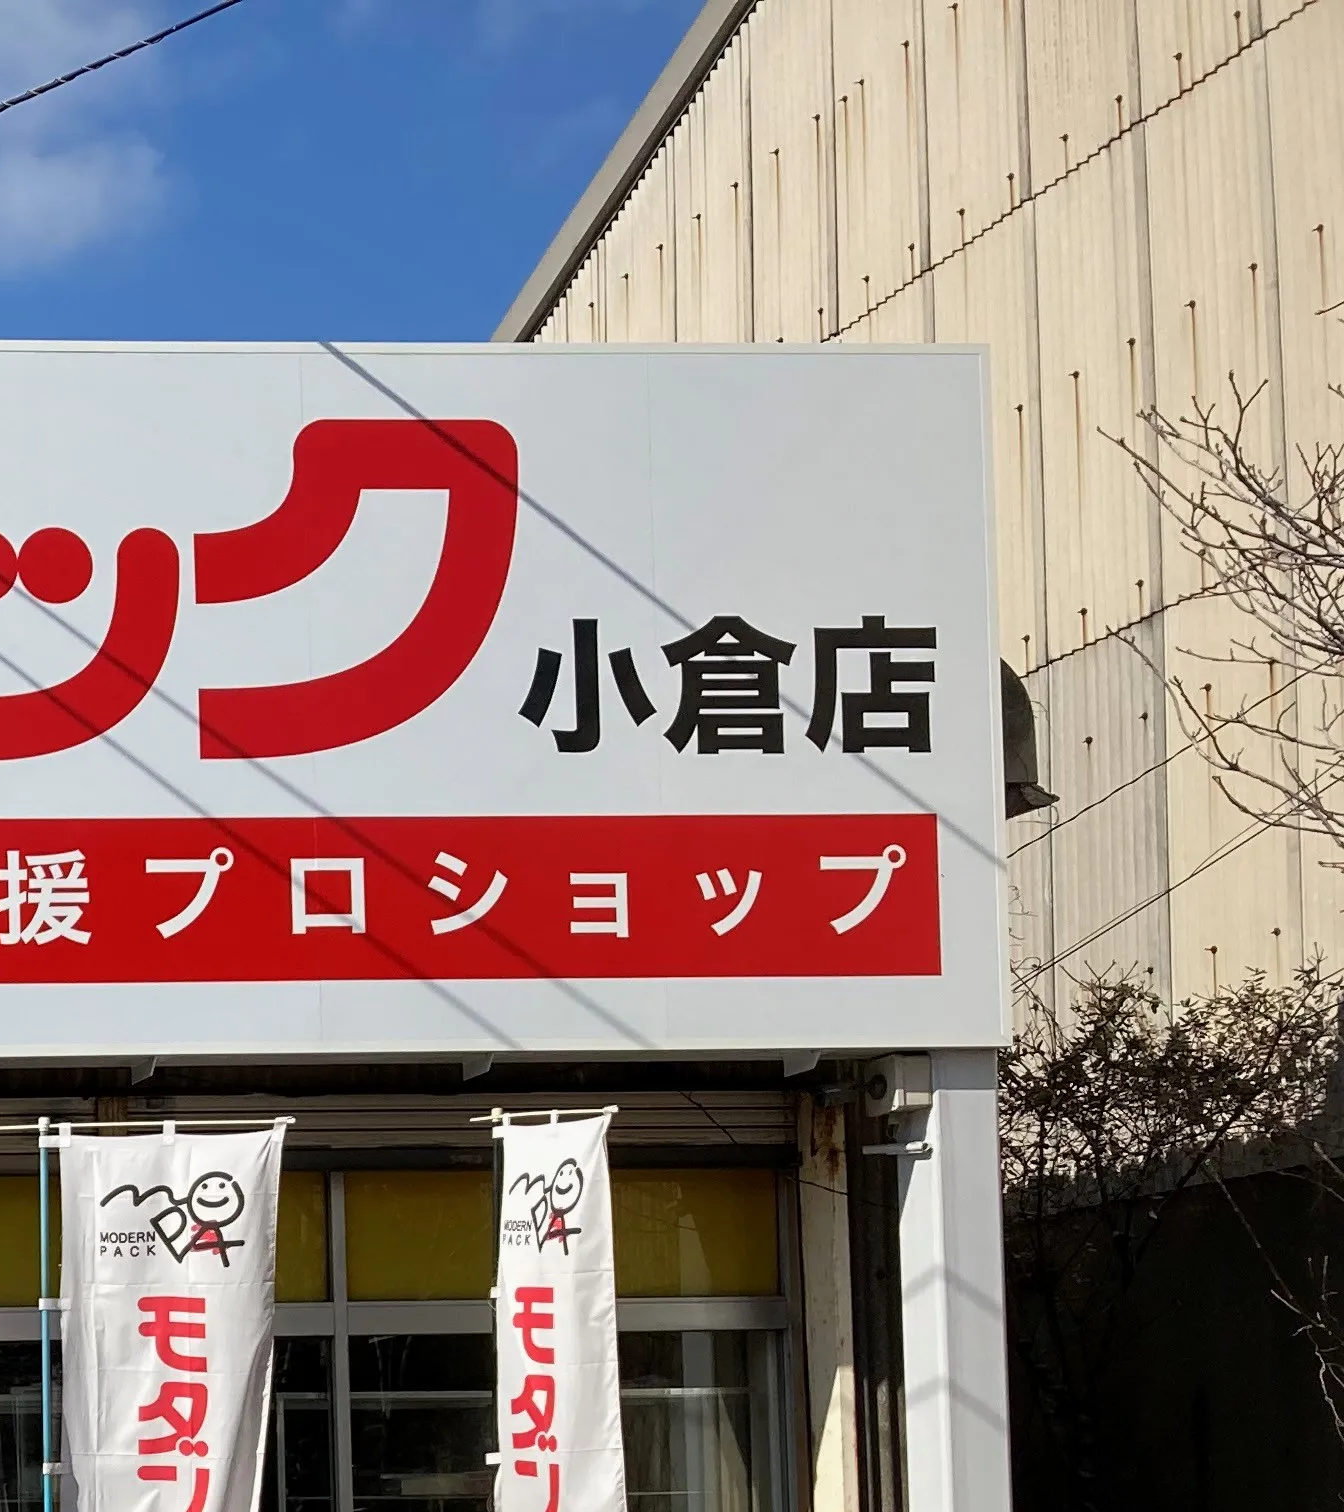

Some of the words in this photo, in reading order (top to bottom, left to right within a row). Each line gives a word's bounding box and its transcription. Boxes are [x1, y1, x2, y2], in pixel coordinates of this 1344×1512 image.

[519, 616, 936, 754] 小倉店
[504, 1220, 532, 1231] MODERN
[100, 1231, 156, 1243] MODERN
[100, 1245, 156, 1257] PACK
